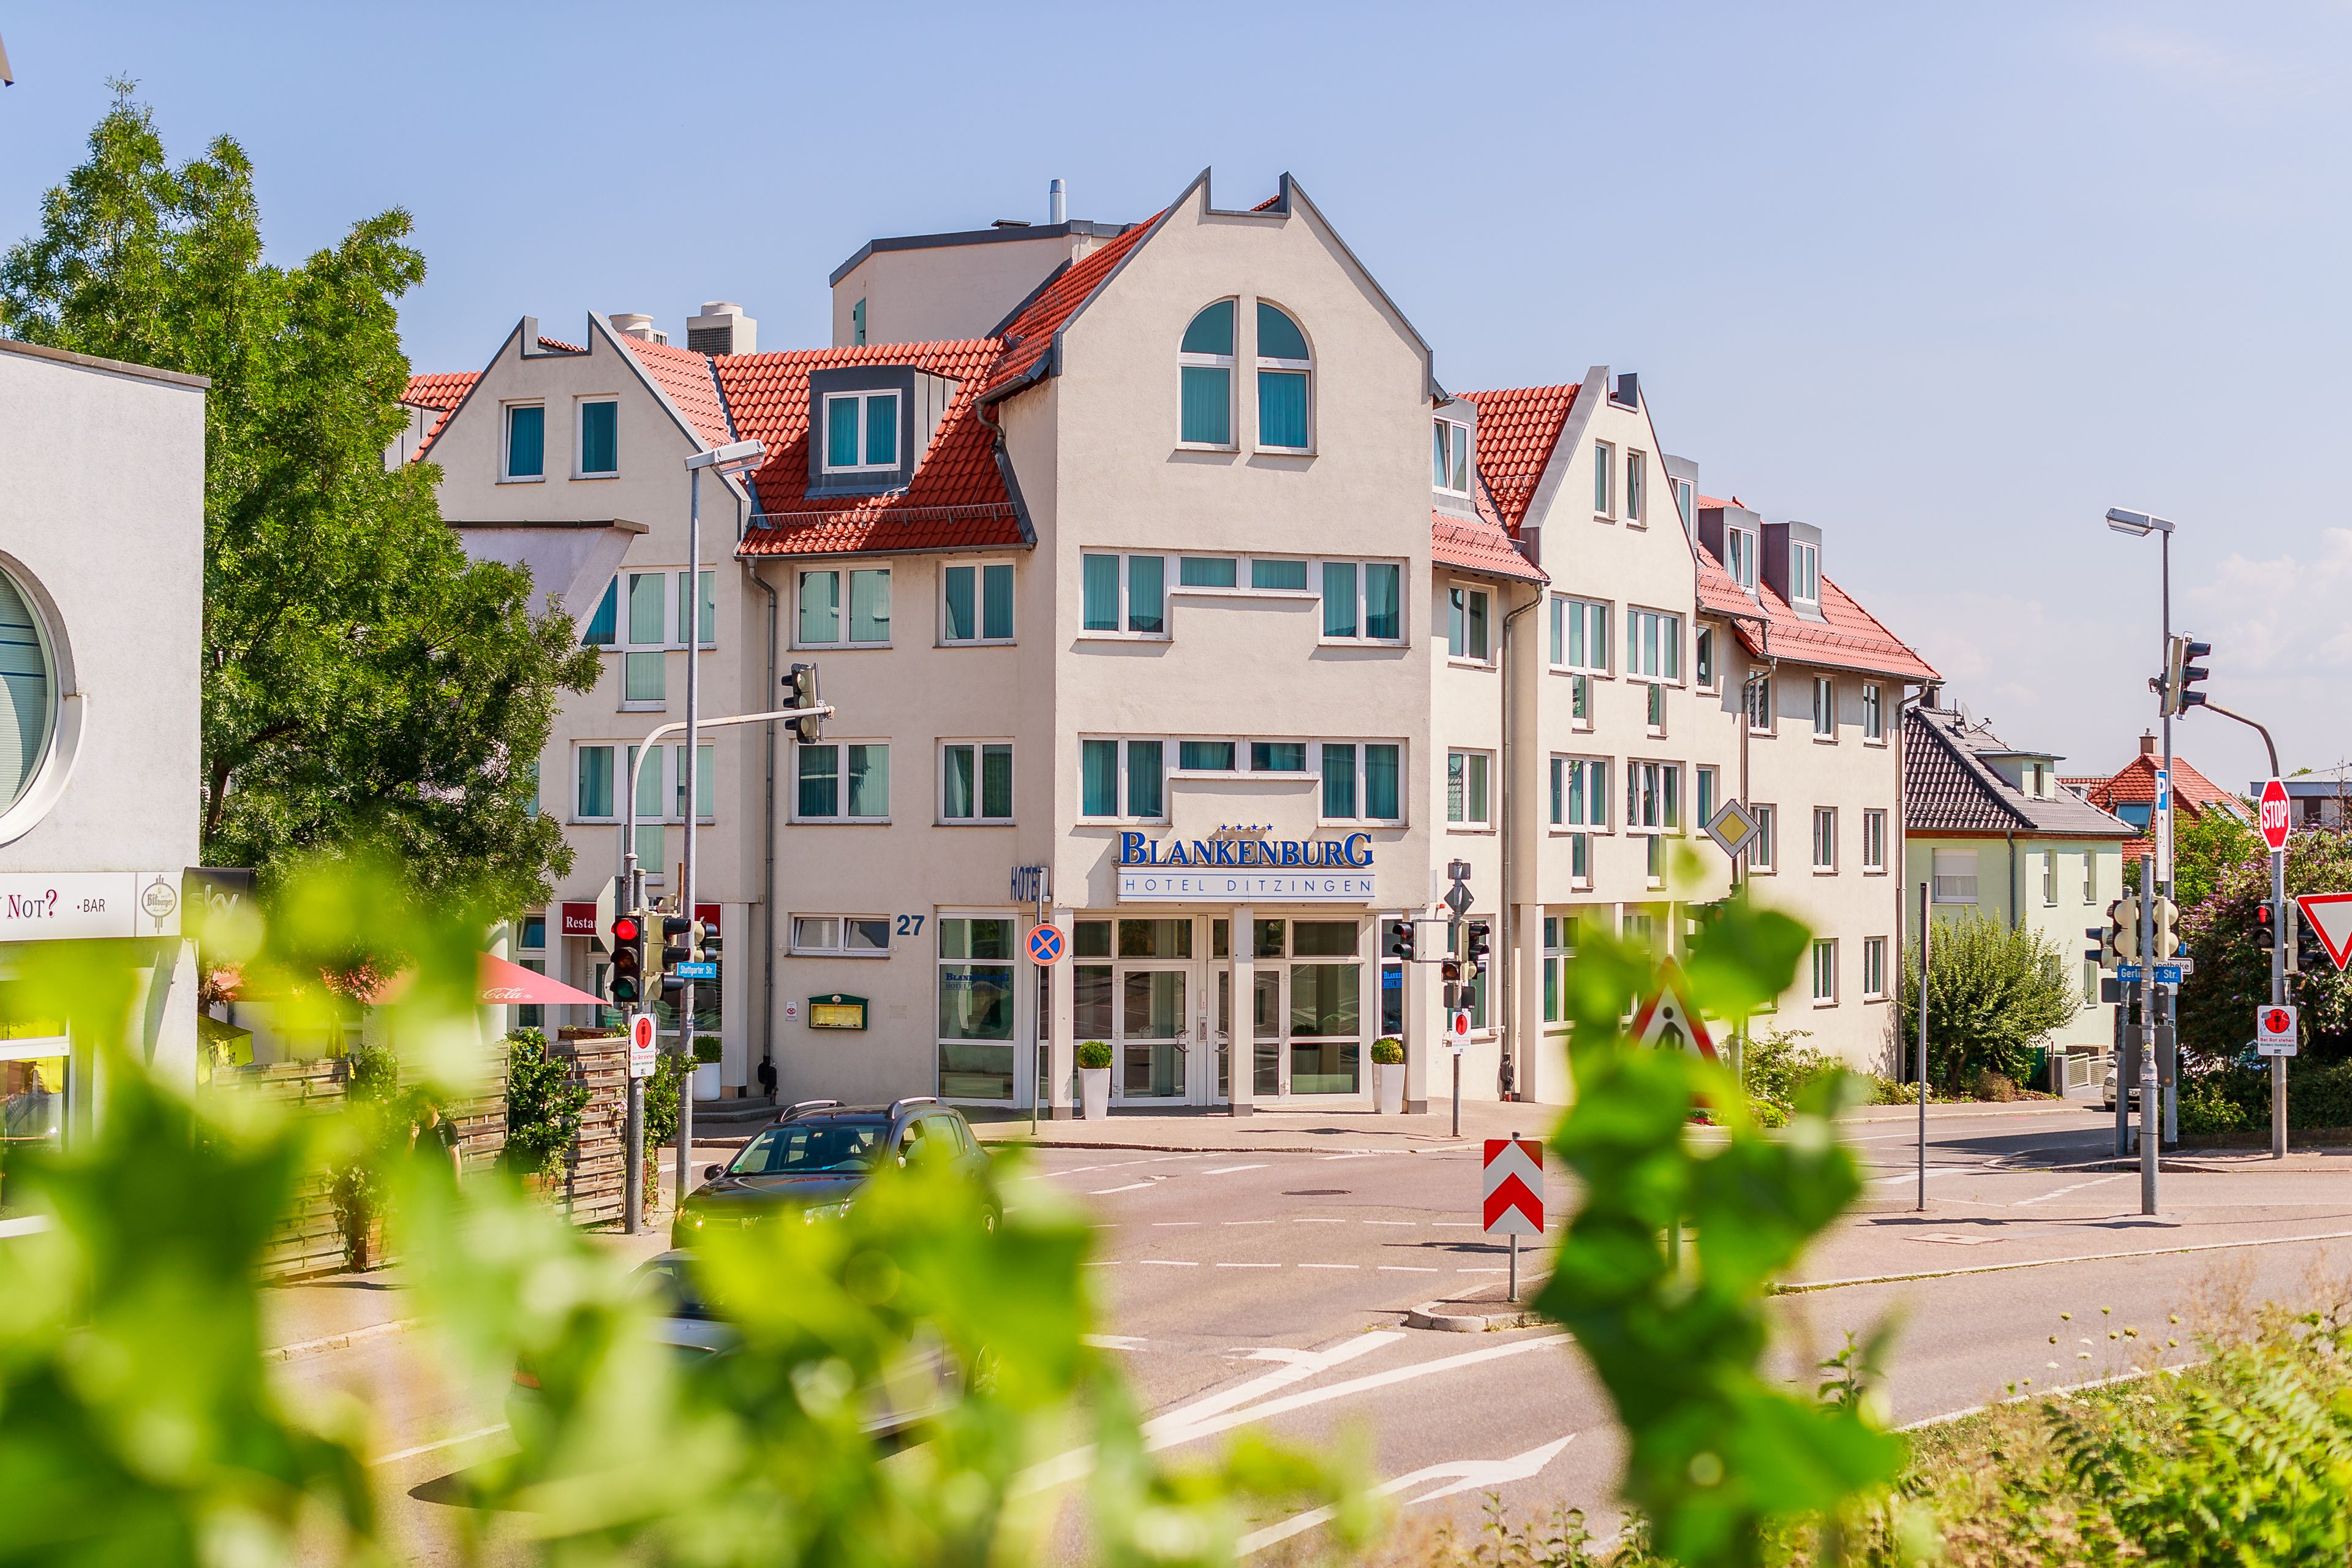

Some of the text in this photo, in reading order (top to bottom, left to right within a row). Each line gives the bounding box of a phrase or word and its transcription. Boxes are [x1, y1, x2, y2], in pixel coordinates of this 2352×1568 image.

[2157, 777, 2166, 804] P
[2263, 800, 2288, 830] STOP
[1120, 831, 1375, 867] BLANKENBURG
[1010, 866, 1039, 902] HOTE
[1125, 878, 1371, 892] HOTEL DITZINGEN
[146, 893, 173, 907] Bitburger
[189, 884, 239, 921] sky
[896, 914, 925, 936] 27
[680, 965, 704, 976] Stuttgarter
[2120, 968, 2178, 979] Gerlir Str.
